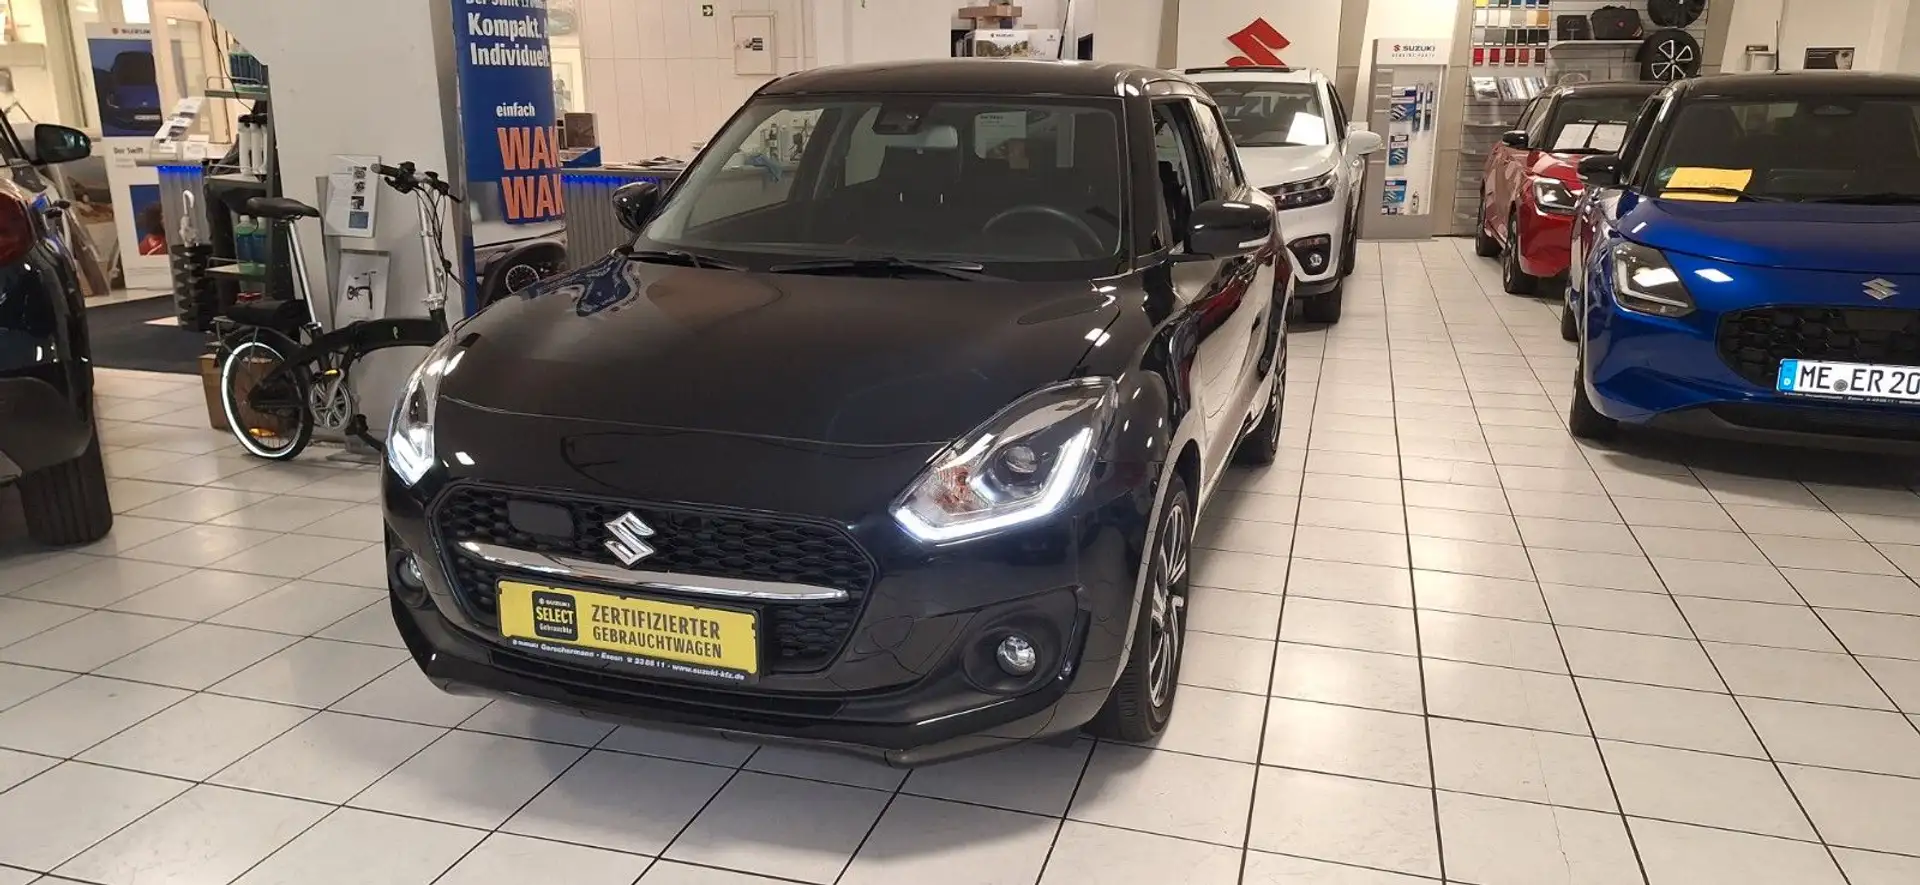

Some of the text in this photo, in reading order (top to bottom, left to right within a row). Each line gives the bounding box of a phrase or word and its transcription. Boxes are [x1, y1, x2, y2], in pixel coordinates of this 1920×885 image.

[467, 12, 543, 41] Kompakt.
[496, 102, 536, 117] einfach
[1799, 365, 1832, 389] ME
[1850, 368, 1884, 393] ER
[545, 599, 571, 607] SUZUKI
[535, 605, 574, 625] SELECT
[591, 604, 721, 640] ZERTIFIZIERTER
[539, 622, 573, 634] Gebrauchte
[593, 625, 722, 658] GEBRAUCHTWAGEN
[600, 652, 623, 662] Essen
